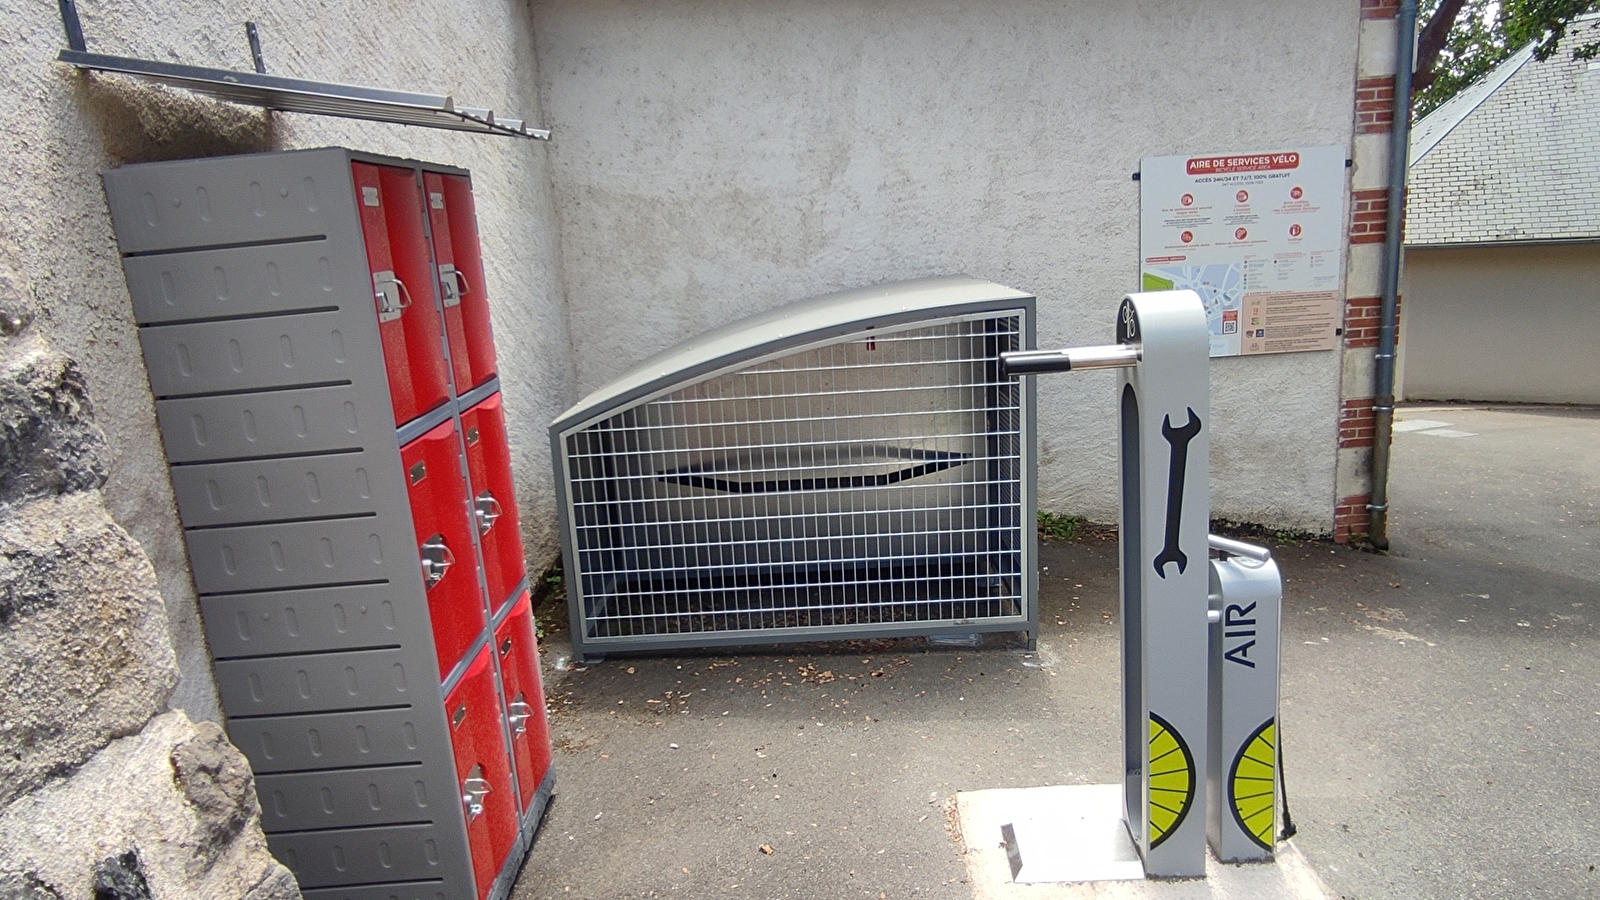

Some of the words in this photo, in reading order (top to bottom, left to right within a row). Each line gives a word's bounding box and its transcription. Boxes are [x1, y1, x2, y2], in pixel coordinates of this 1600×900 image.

[1190, 160, 1211, 169] AIRE
[1213, 159, 1225, 168] DE
[1227, 156, 1270, 167] SERVICES
[1272, 154, 1296, 164] VÉLO
[1225, 601, 1256, 668] AIR
